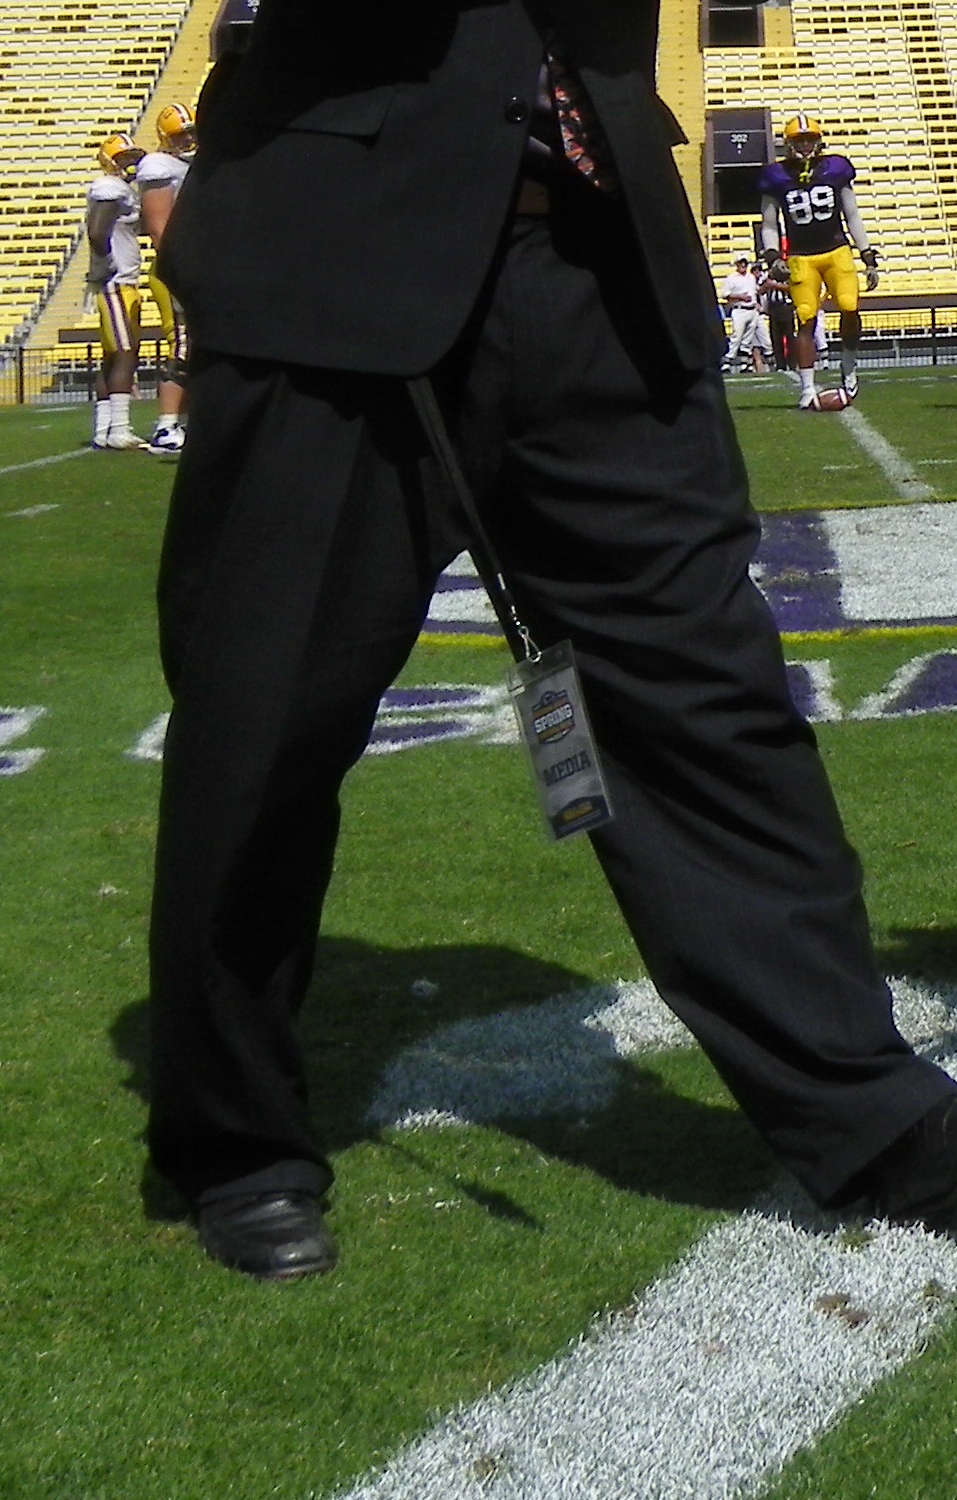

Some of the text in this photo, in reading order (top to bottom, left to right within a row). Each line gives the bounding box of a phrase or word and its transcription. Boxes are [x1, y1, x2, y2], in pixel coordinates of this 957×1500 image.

[785, 184, 835, 225] 89
[533, 703, 573, 734] SPRING
[543, 749, 592, 787] MEDIA
